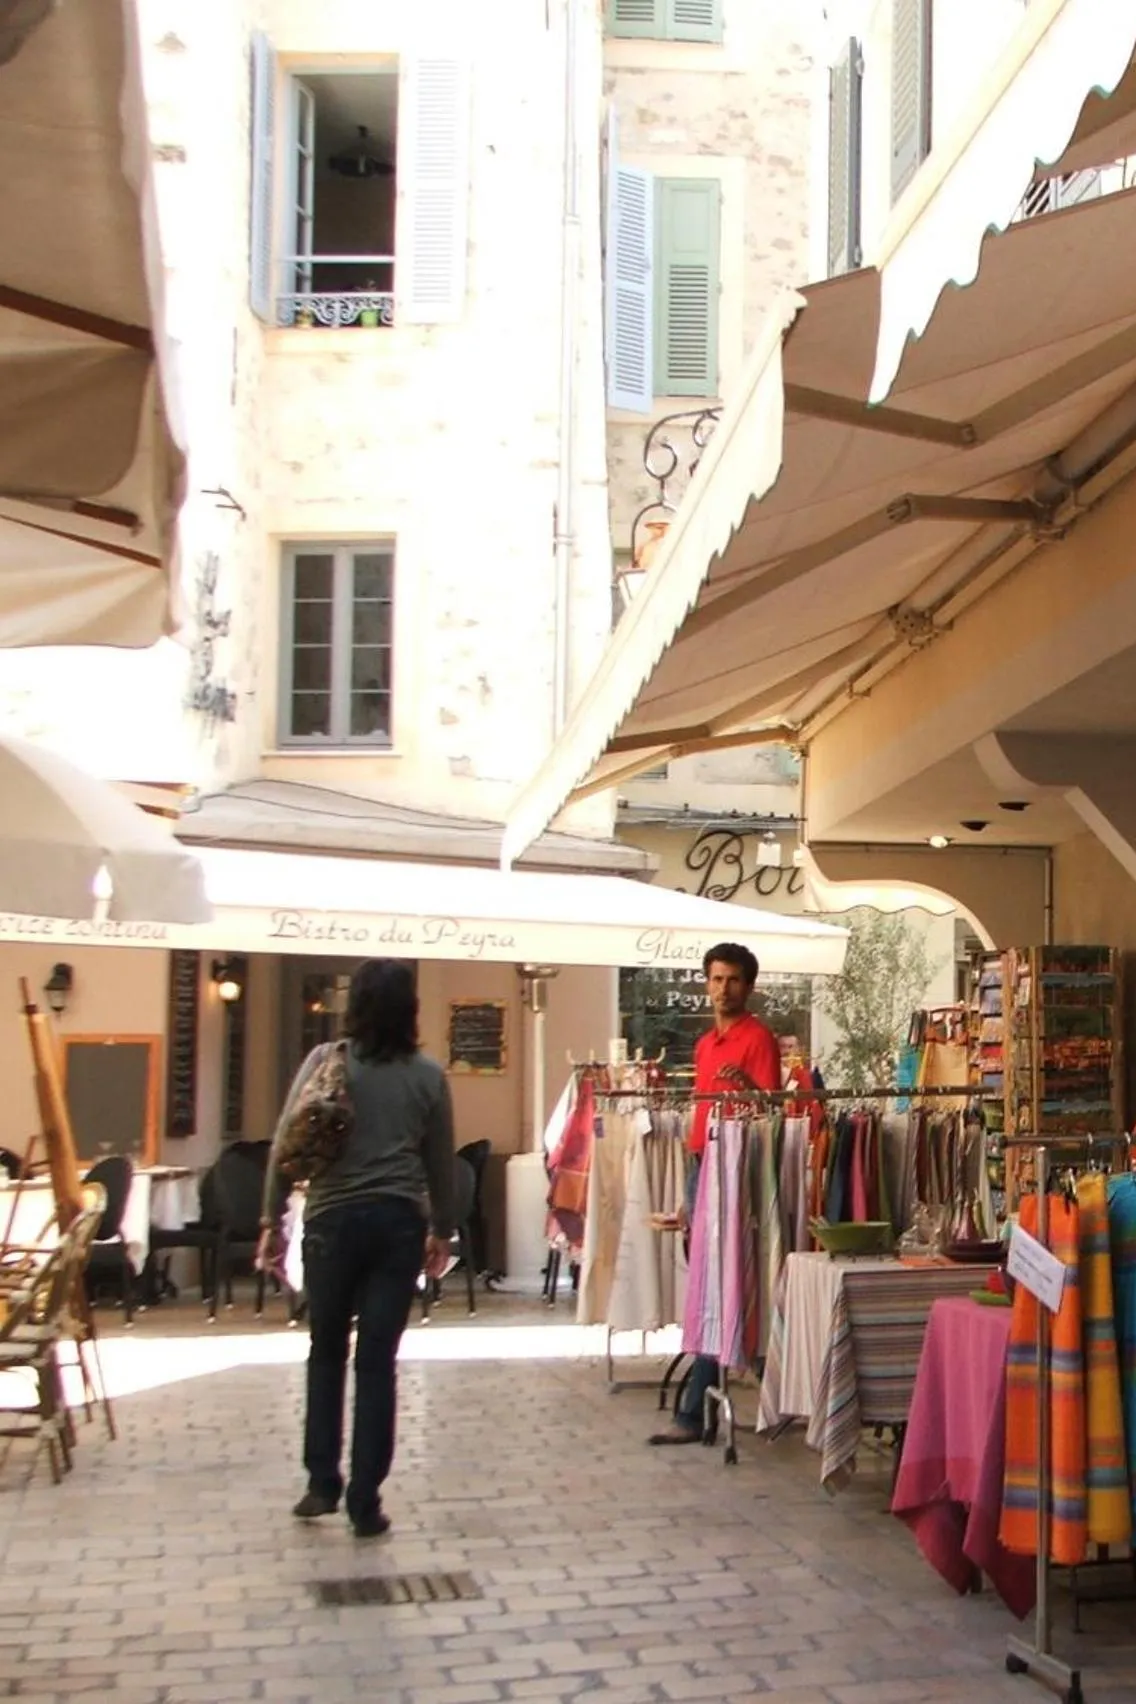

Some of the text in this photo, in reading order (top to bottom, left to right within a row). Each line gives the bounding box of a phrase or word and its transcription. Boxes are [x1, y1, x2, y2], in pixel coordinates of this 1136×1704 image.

[268, 909, 516, 958] Bistro du Peyra
